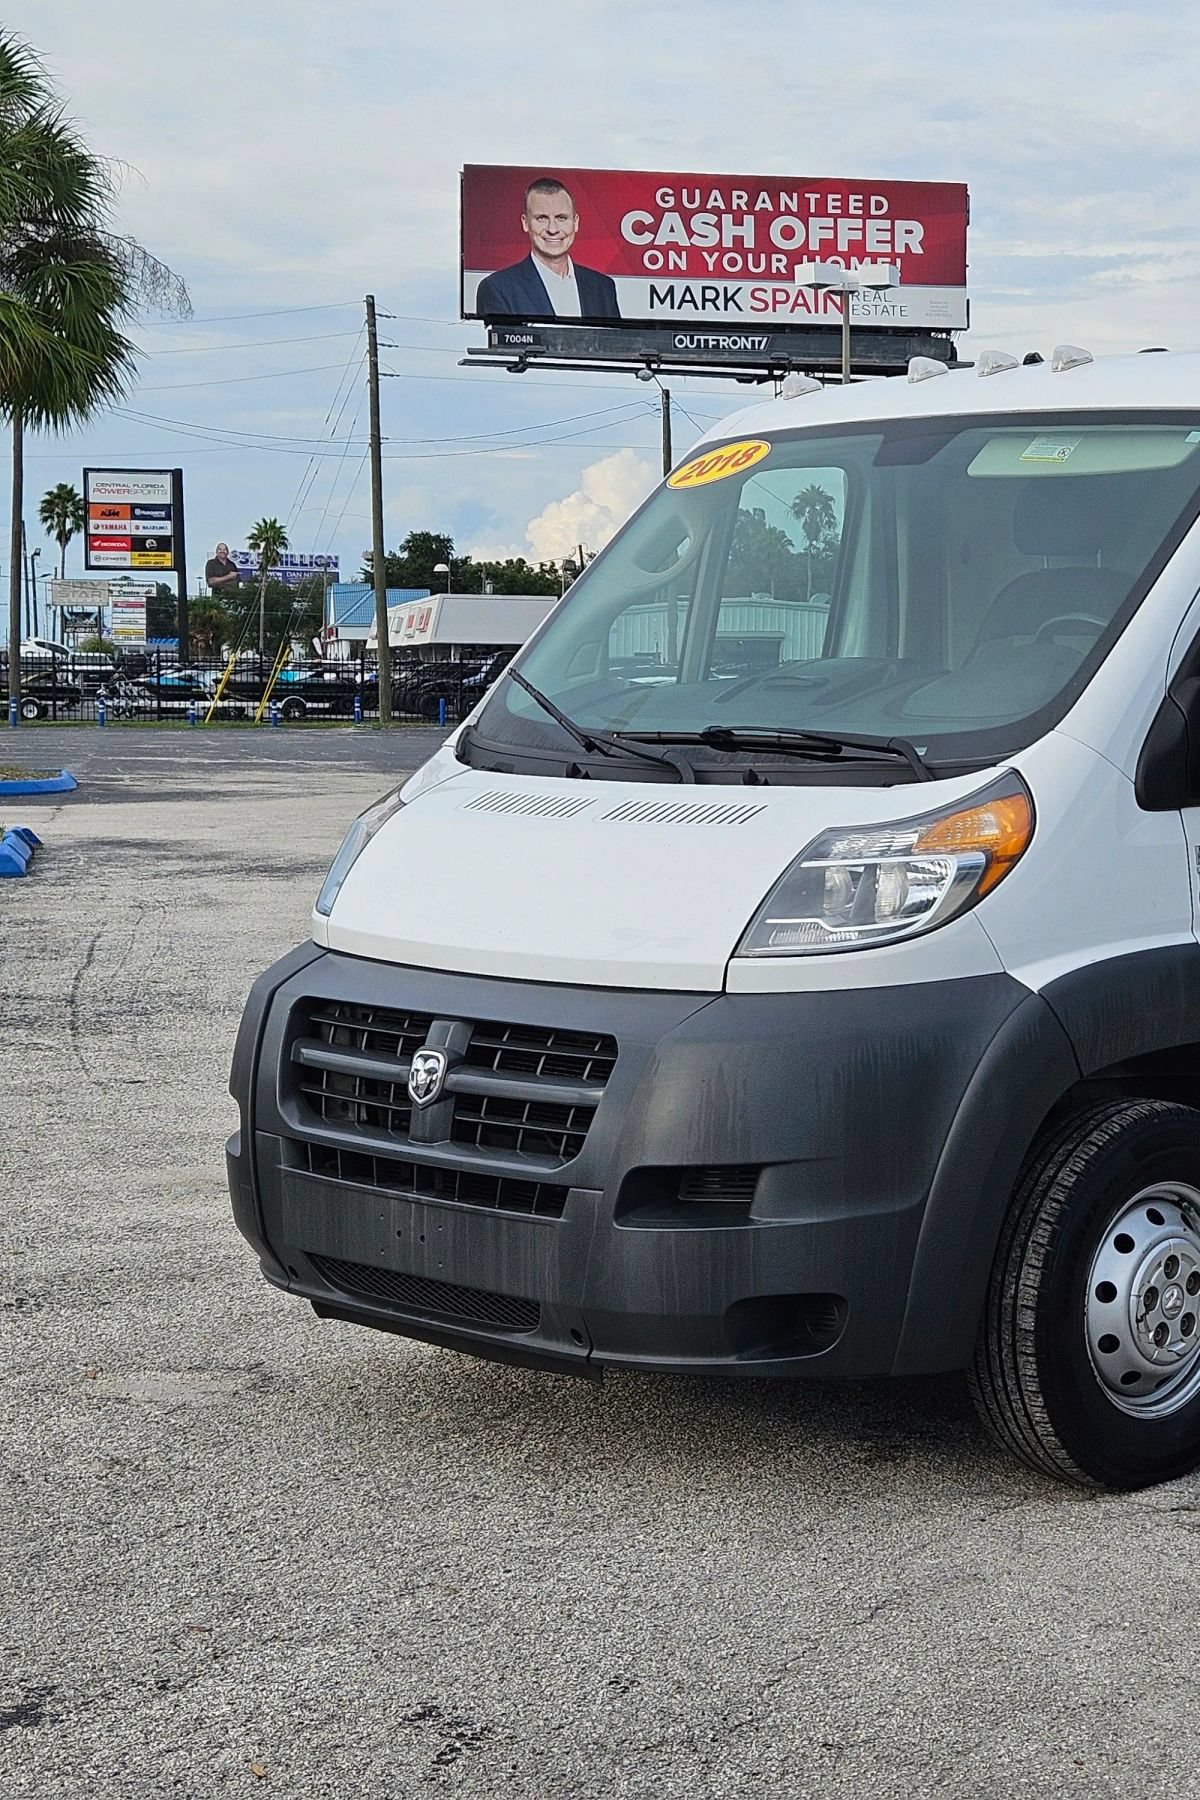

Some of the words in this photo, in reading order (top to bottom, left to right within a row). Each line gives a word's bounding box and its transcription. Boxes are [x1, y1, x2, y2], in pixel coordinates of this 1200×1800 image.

[655, 187, 889, 216] GUARANTEED
[620, 210, 755, 248] CASH
[769, 215, 924, 254] OFFER
[642, 249, 687, 271] ON
[701, 251, 788, 274] YOUR
[649, 284, 744, 312] MARK
[749, 287, 843, 314] SPAIN
[851, 290, 892, 303] REAL
[851, 304, 909, 317] ESTATE
[504, 334, 534, 344] 7004N
[674, 445, 762, 485] 2018
[92, 487, 168, 496] POWERSPORTS
[101, 509, 120, 517] KTM
[57, 589, 103, 598] STAR
